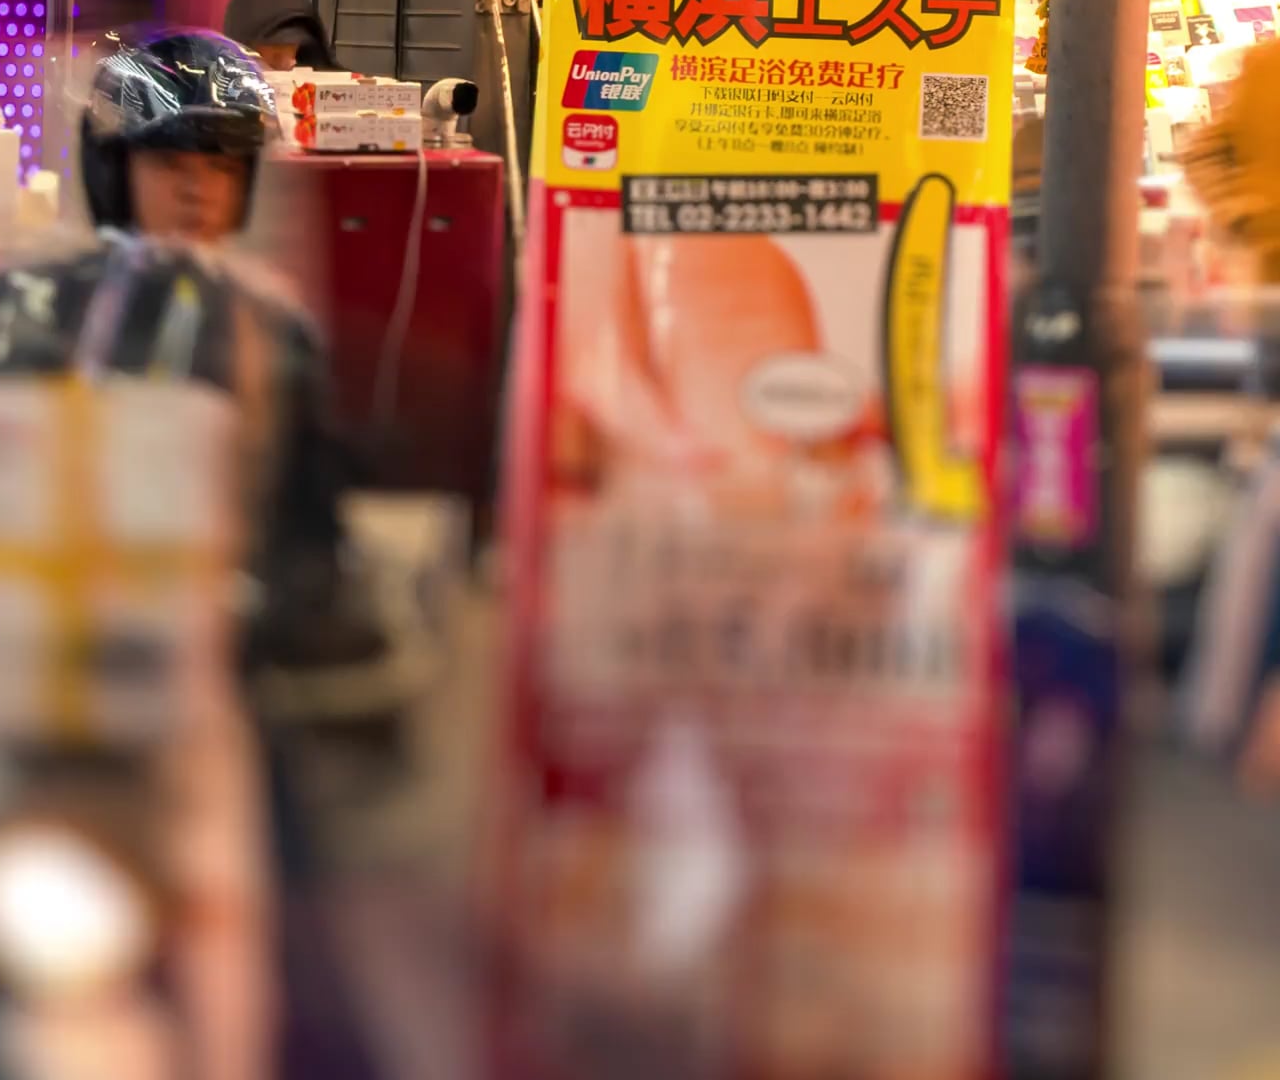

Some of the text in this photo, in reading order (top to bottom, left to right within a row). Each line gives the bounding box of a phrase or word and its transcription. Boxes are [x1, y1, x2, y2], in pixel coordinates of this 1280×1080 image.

[571, 64, 651, 87] UnionPay
[670, 54, 905, 90] 横滨足浴免费足疗
[600, 84, 644, 101] 银联
